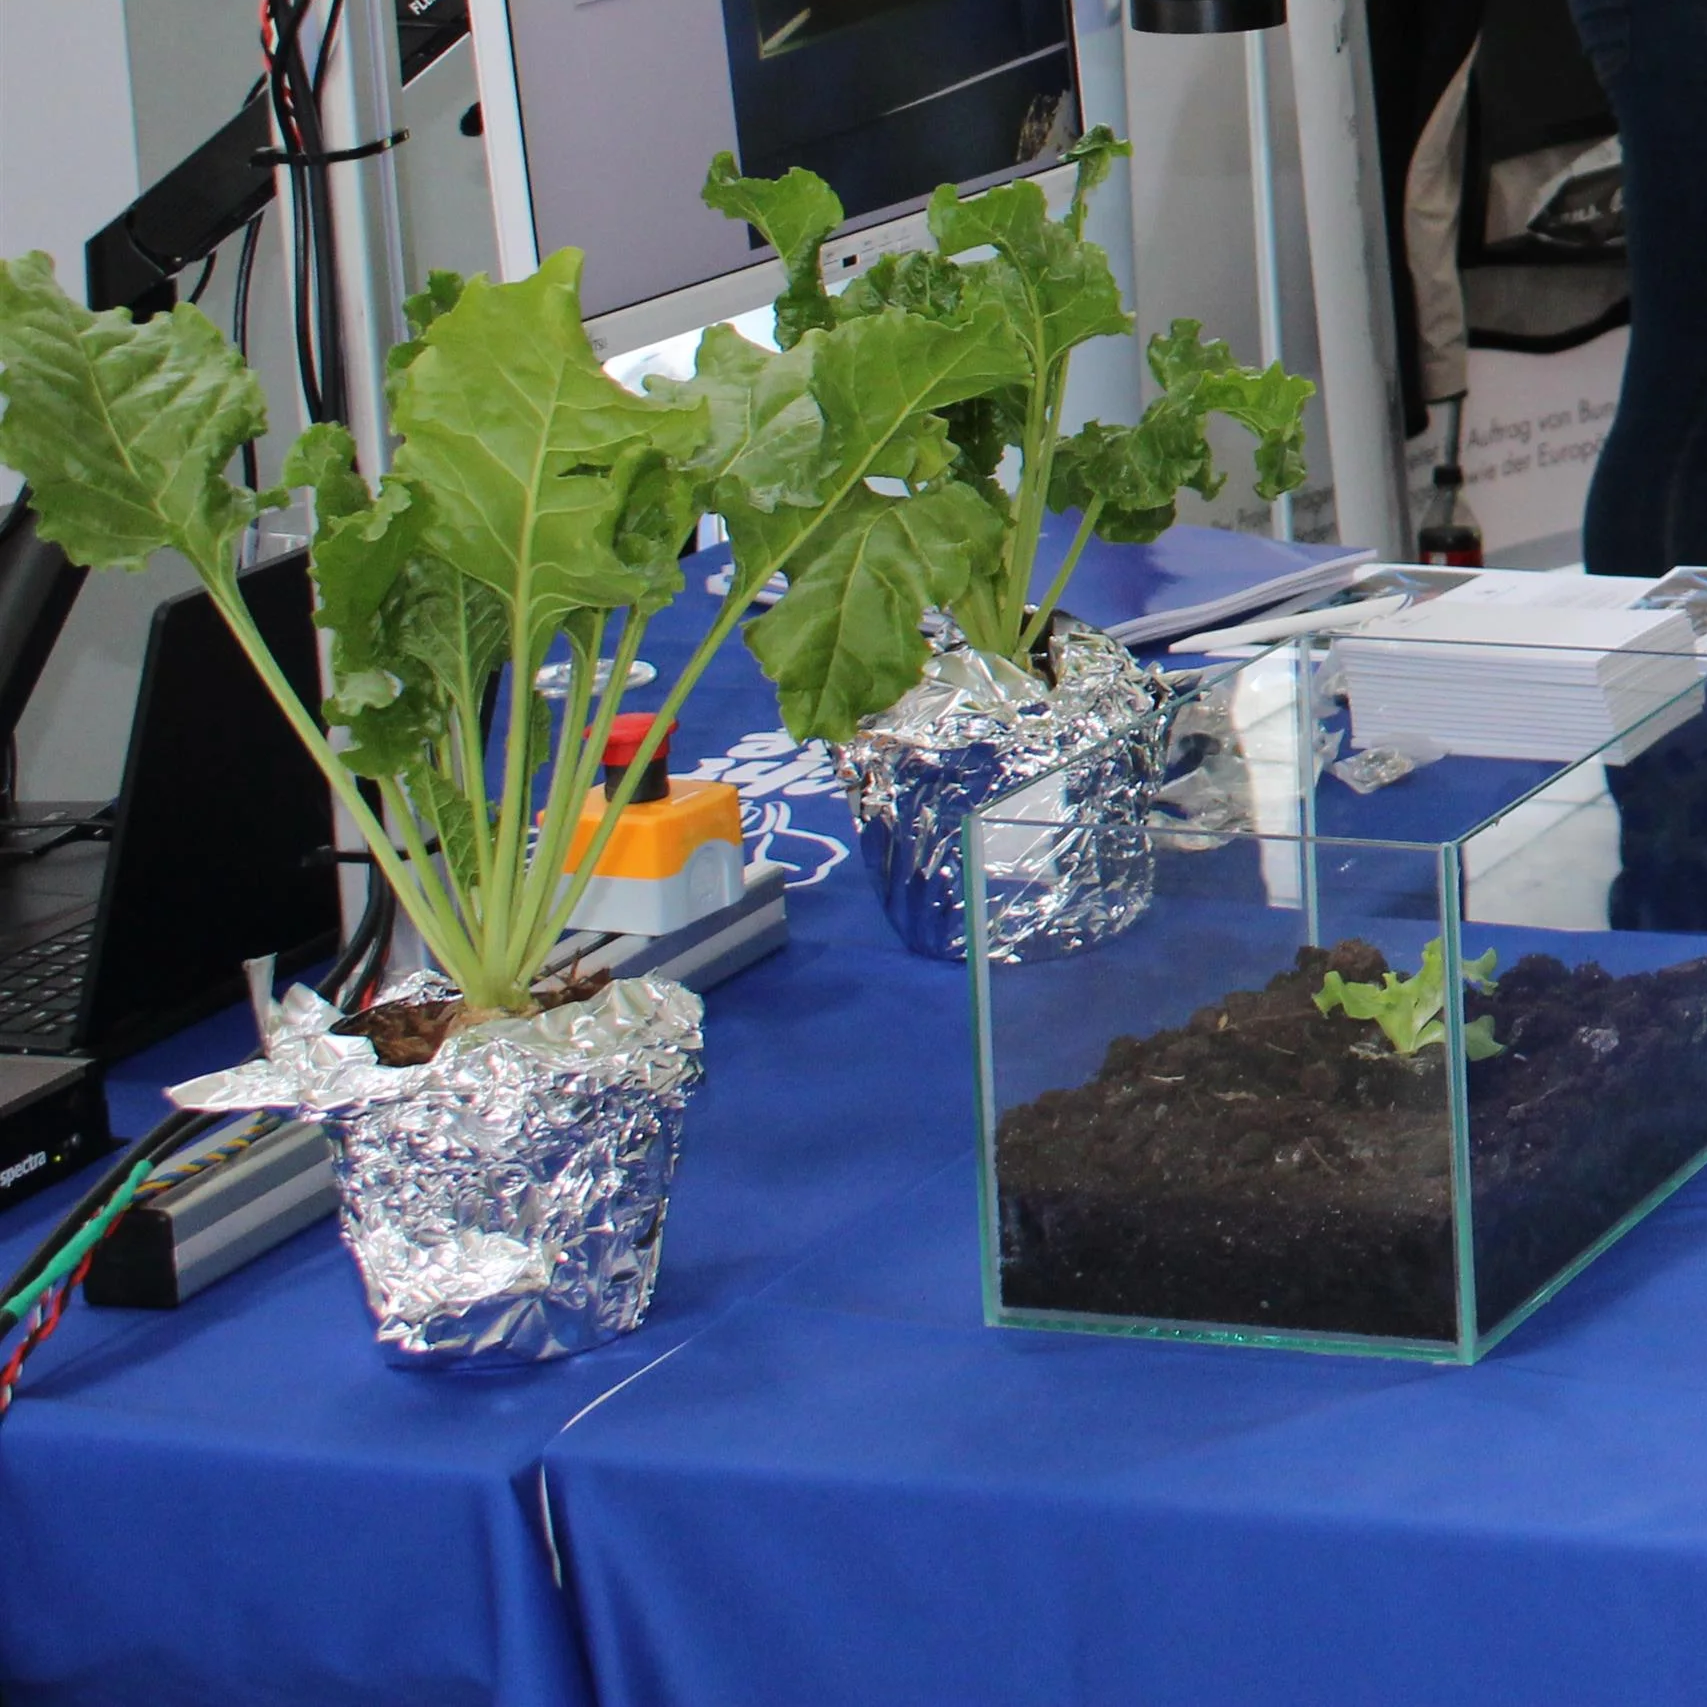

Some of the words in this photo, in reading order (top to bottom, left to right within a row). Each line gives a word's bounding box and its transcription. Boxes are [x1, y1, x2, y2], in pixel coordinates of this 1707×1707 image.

[1465, 415, 1532, 449] Auftrag
[1537, 408, 1573, 434] von
[1577, 397, 1617, 425] Bun
[1467, 464, 1498, 485] wie
[1501, 447, 1531, 478] der
[1537, 432, 1602, 470] Europ
